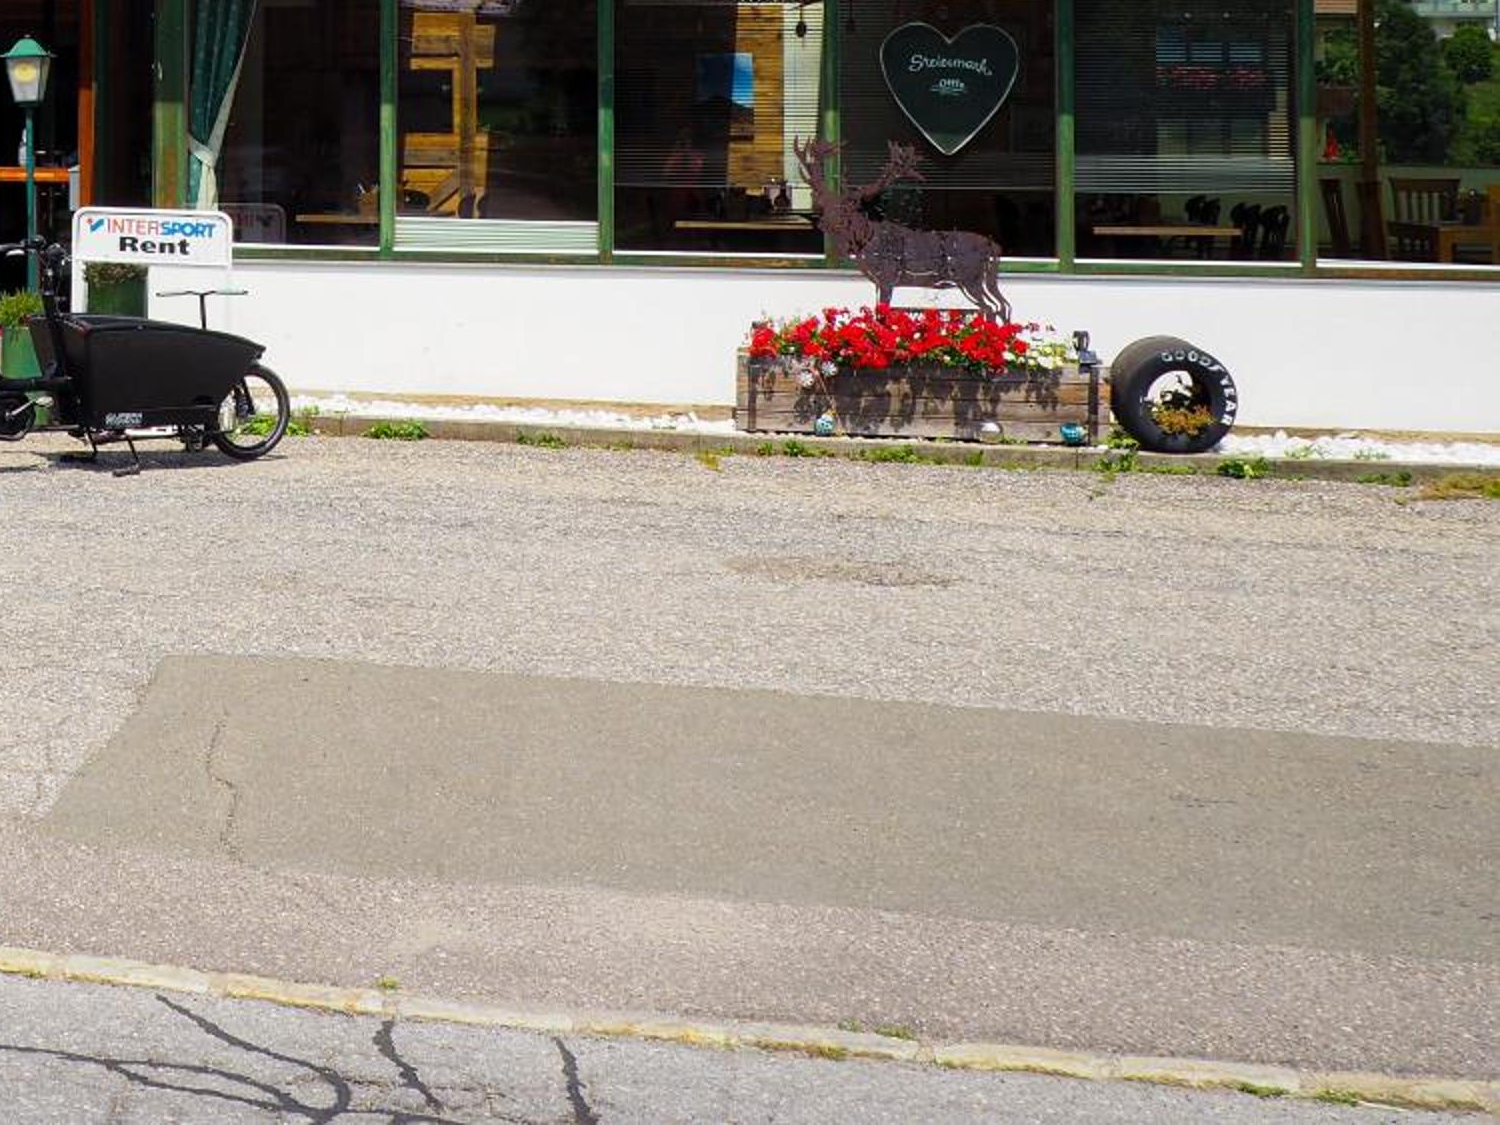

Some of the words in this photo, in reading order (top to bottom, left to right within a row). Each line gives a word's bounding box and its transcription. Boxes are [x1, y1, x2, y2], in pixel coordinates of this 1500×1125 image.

[107, 218, 216, 238] INTERSPORT
[119, 236, 190, 255] Rent
[1161, 350, 1237, 425] GOODYEAR
